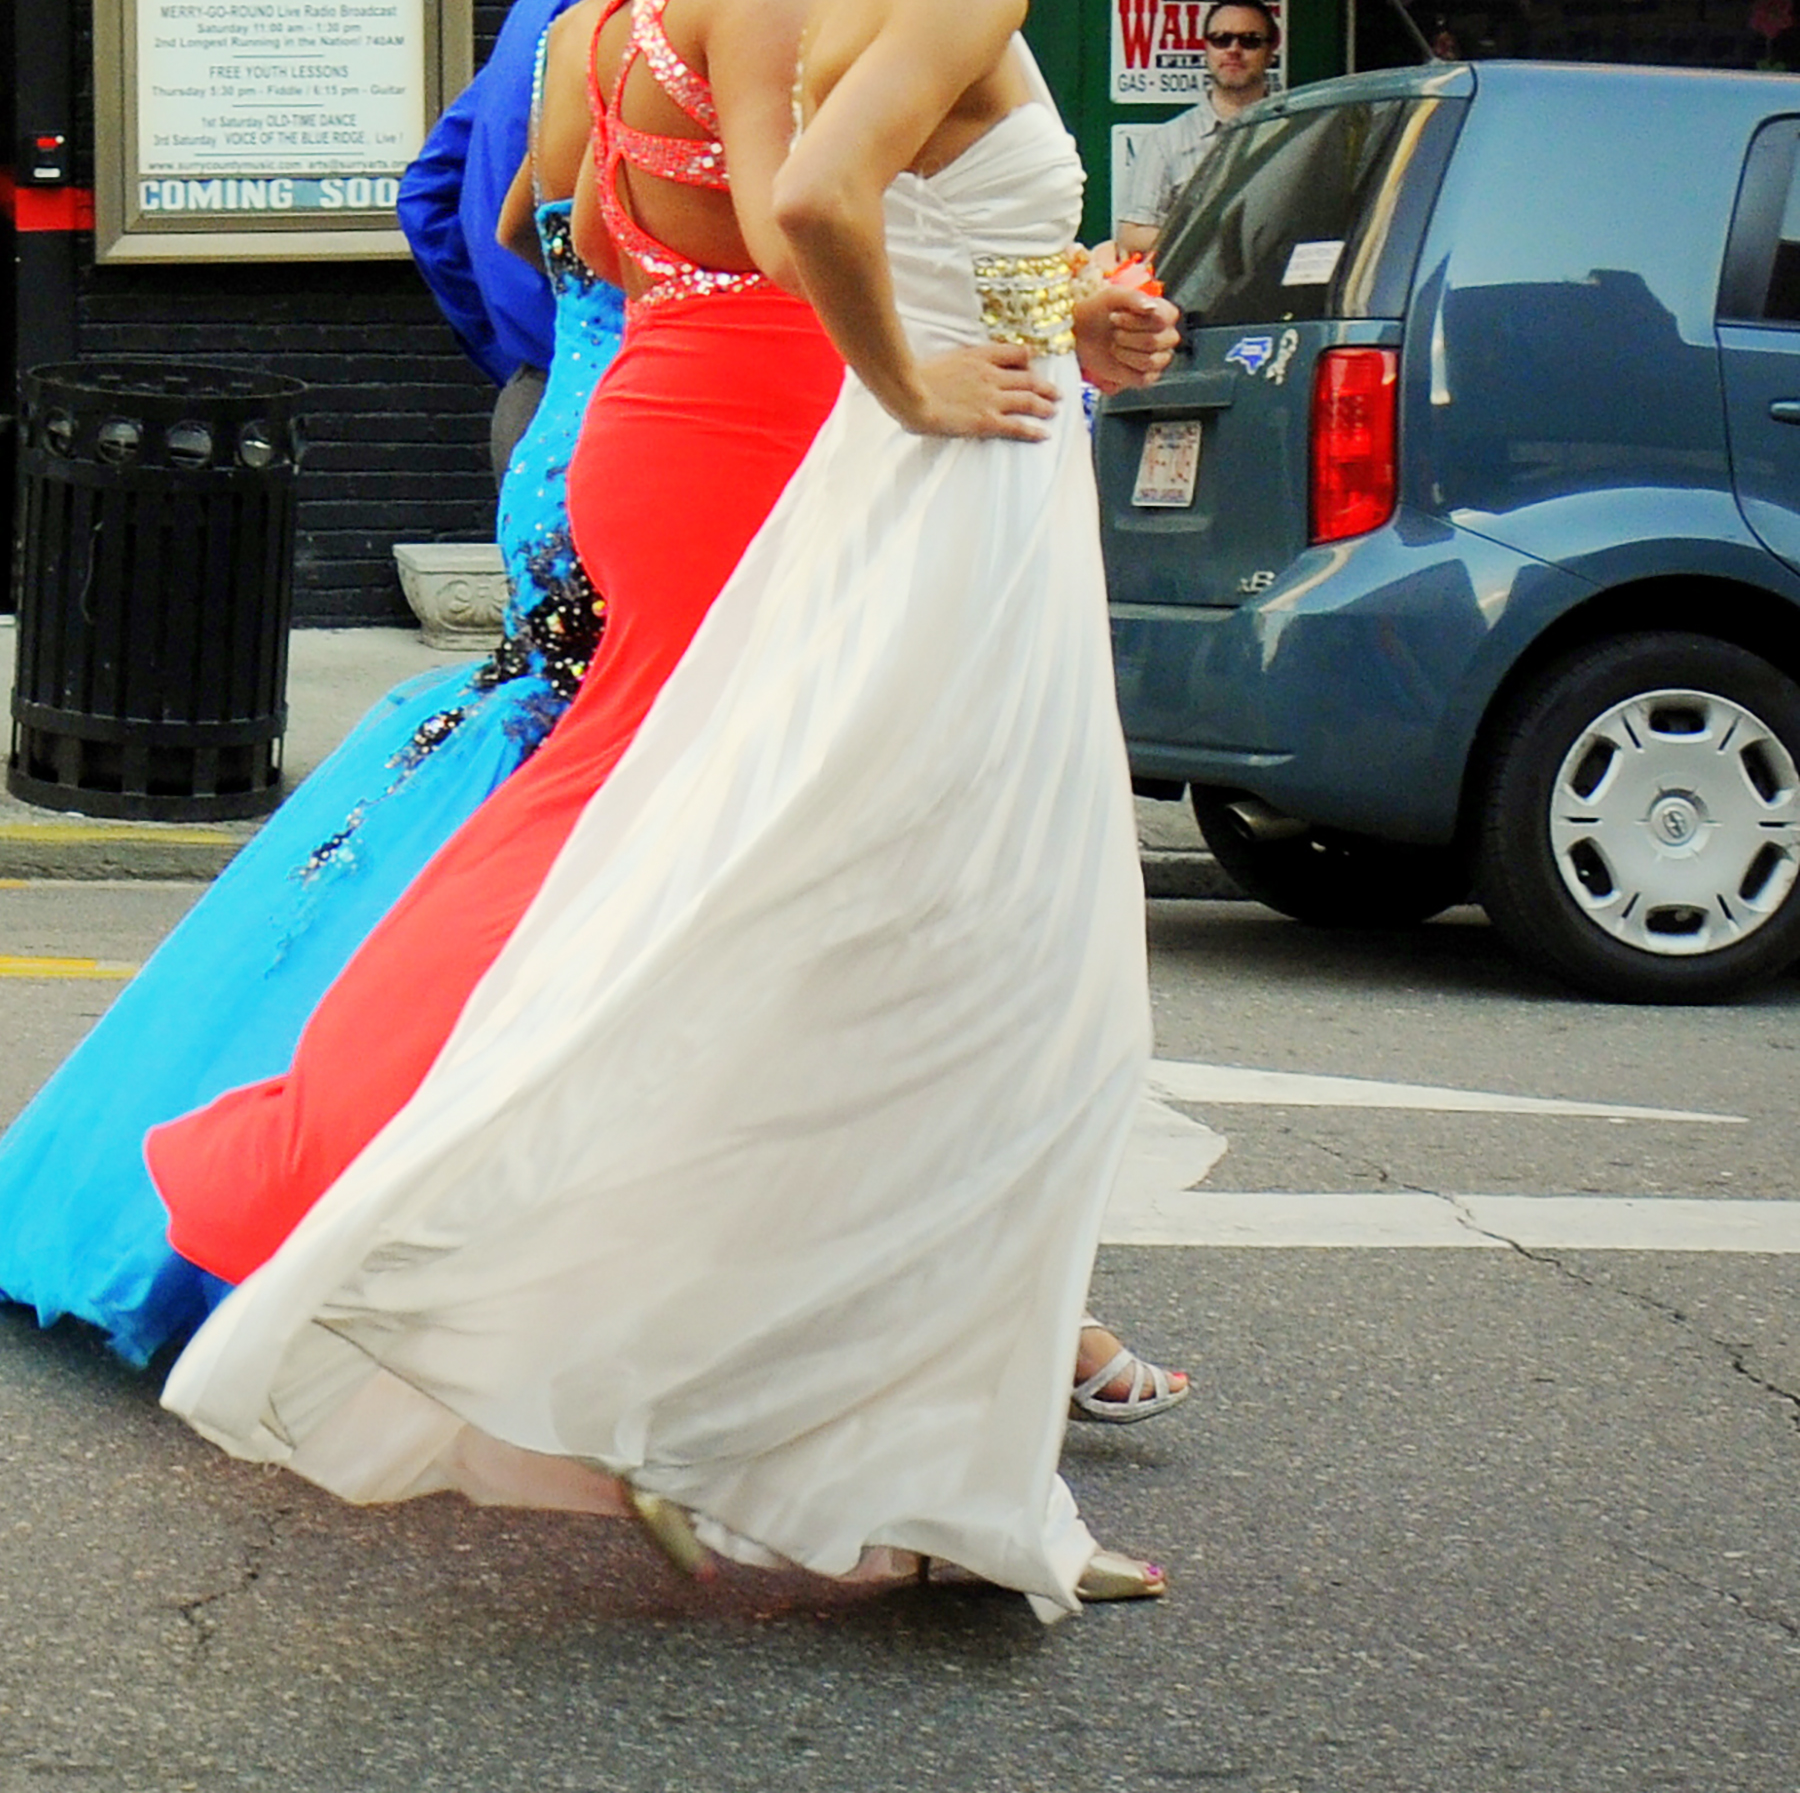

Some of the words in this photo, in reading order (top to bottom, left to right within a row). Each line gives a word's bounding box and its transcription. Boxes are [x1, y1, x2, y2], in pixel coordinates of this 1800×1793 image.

[304, 5, 337, 18] Radio
[340, 4, 398, 18] Broadcast
[197, 23, 248, 36] Saturday
[209, 66, 241, 79] FREE
[246, 65, 287, 78] YOUTH
[291, 65, 349, 78] LESSONS
[1117, 73, 1147, 92] GAS
[1160, 73, 1200, 92] SODA
[319, 113, 357, 127] DANCE
[225, 131, 256, 145] VOICE
[259, 131, 273, 145] OF
[278, 131, 298, 145] THE
[301, 130, 329, 144] BLUE
[139, 178, 293, 211] COMING
[318, 177, 400, 209] SOO
